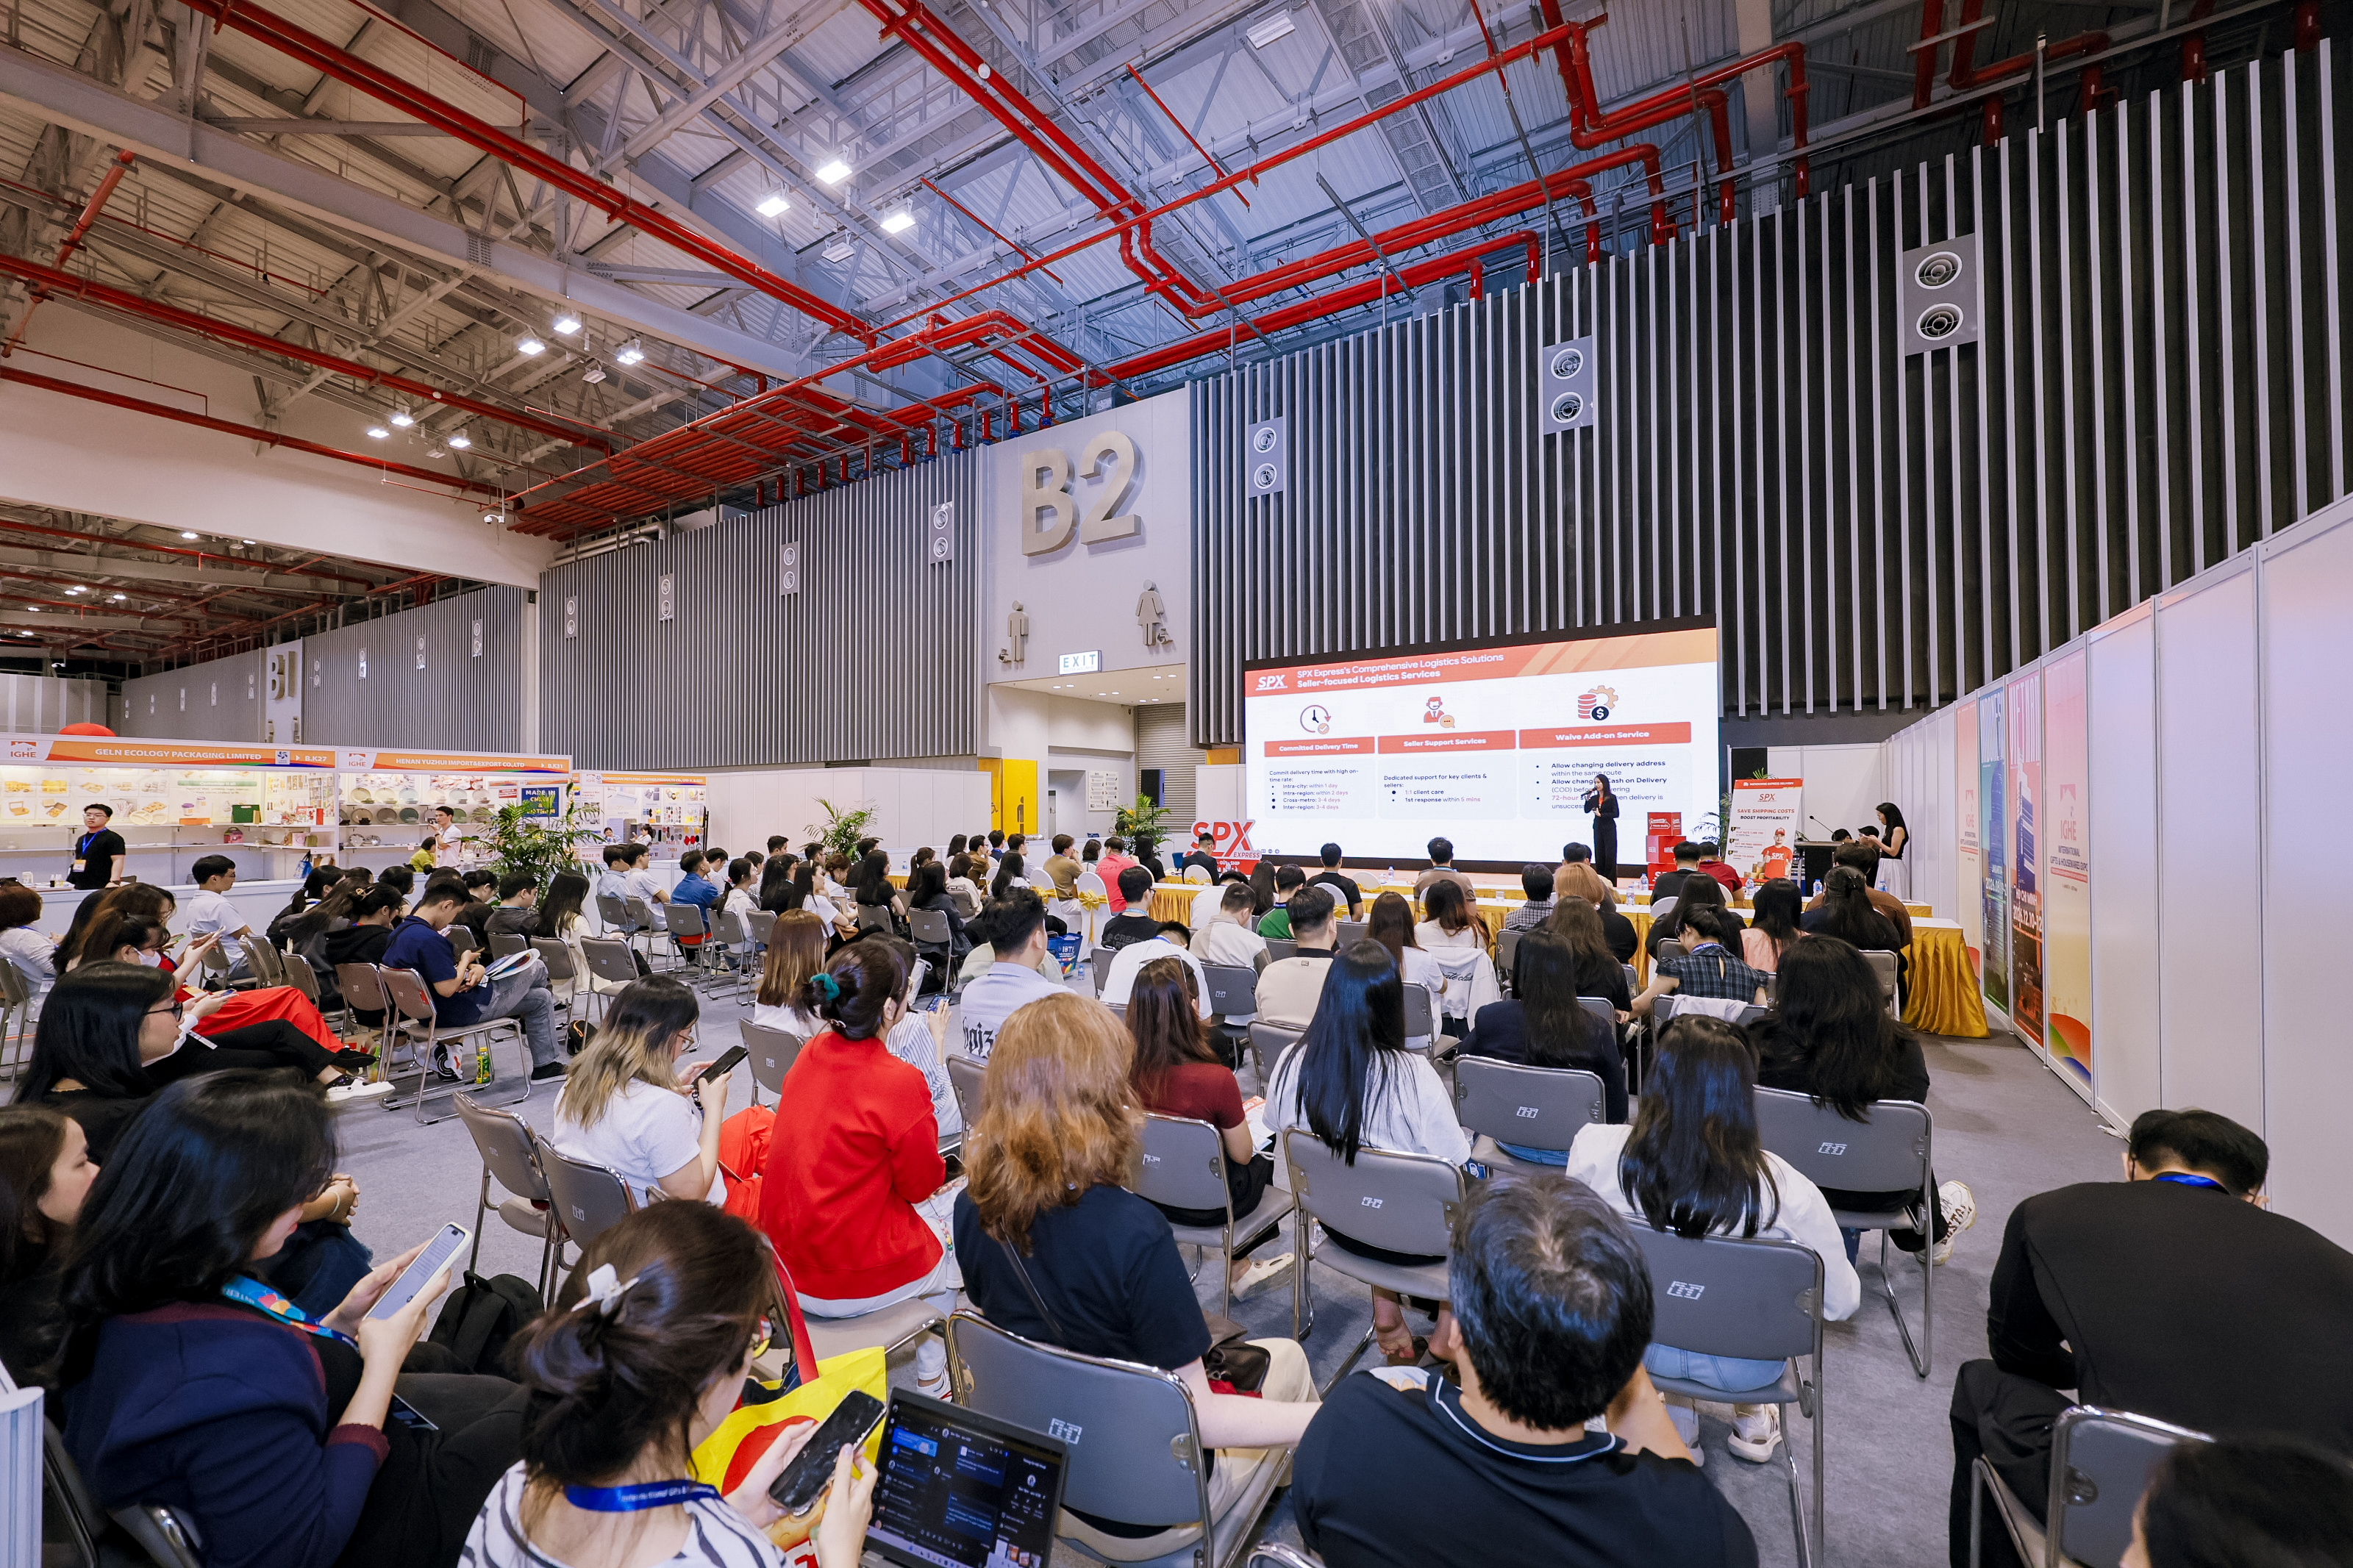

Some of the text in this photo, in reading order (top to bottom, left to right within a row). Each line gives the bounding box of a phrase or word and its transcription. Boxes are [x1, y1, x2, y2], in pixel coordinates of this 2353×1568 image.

[1022, 430, 1140, 556] B2
[1063, 654, 1096, 668] EXIT
[1297, 654, 1504, 678] SPX Express's Comprehensive Logistics Solutions
[268, 651, 297, 701] B1
[1257, 675, 1285, 689] SPX
[1297, 670, 1440, 688] Seller-focused Logistics Services
[1583, 732, 1615, 740] Add-on
[1616, 731, 1649, 739] Service
[124, 749, 169, 757] ECOLOGY
[171, 751, 225, 759] PACKAGING
[1279, 744, 1314, 752] Committed
[1759, 793, 1776, 801] SPX
[1190, 822, 1254, 853] SPX
[2060, 820, 2077, 841] IGHE
